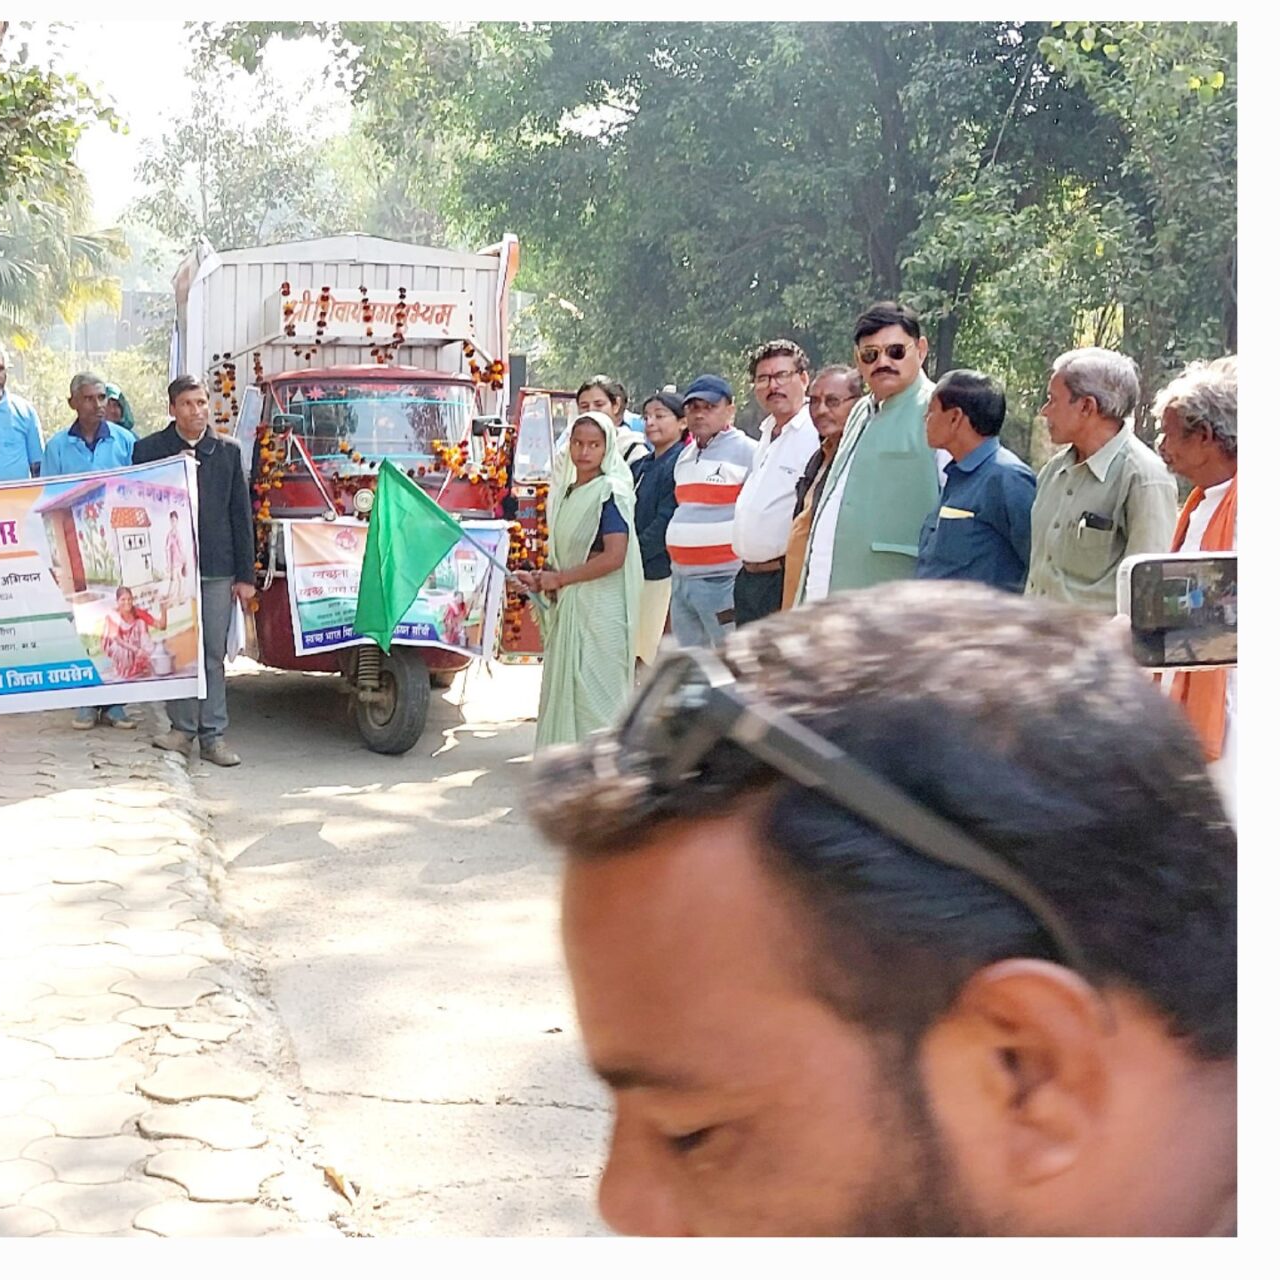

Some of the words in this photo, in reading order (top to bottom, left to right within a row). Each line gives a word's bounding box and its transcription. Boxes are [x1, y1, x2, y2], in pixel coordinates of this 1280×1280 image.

[1, 573, 41, 588] अभियान
[6, 670, 43, 689] जिला
[47, 664, 94, 684] रायसेन
